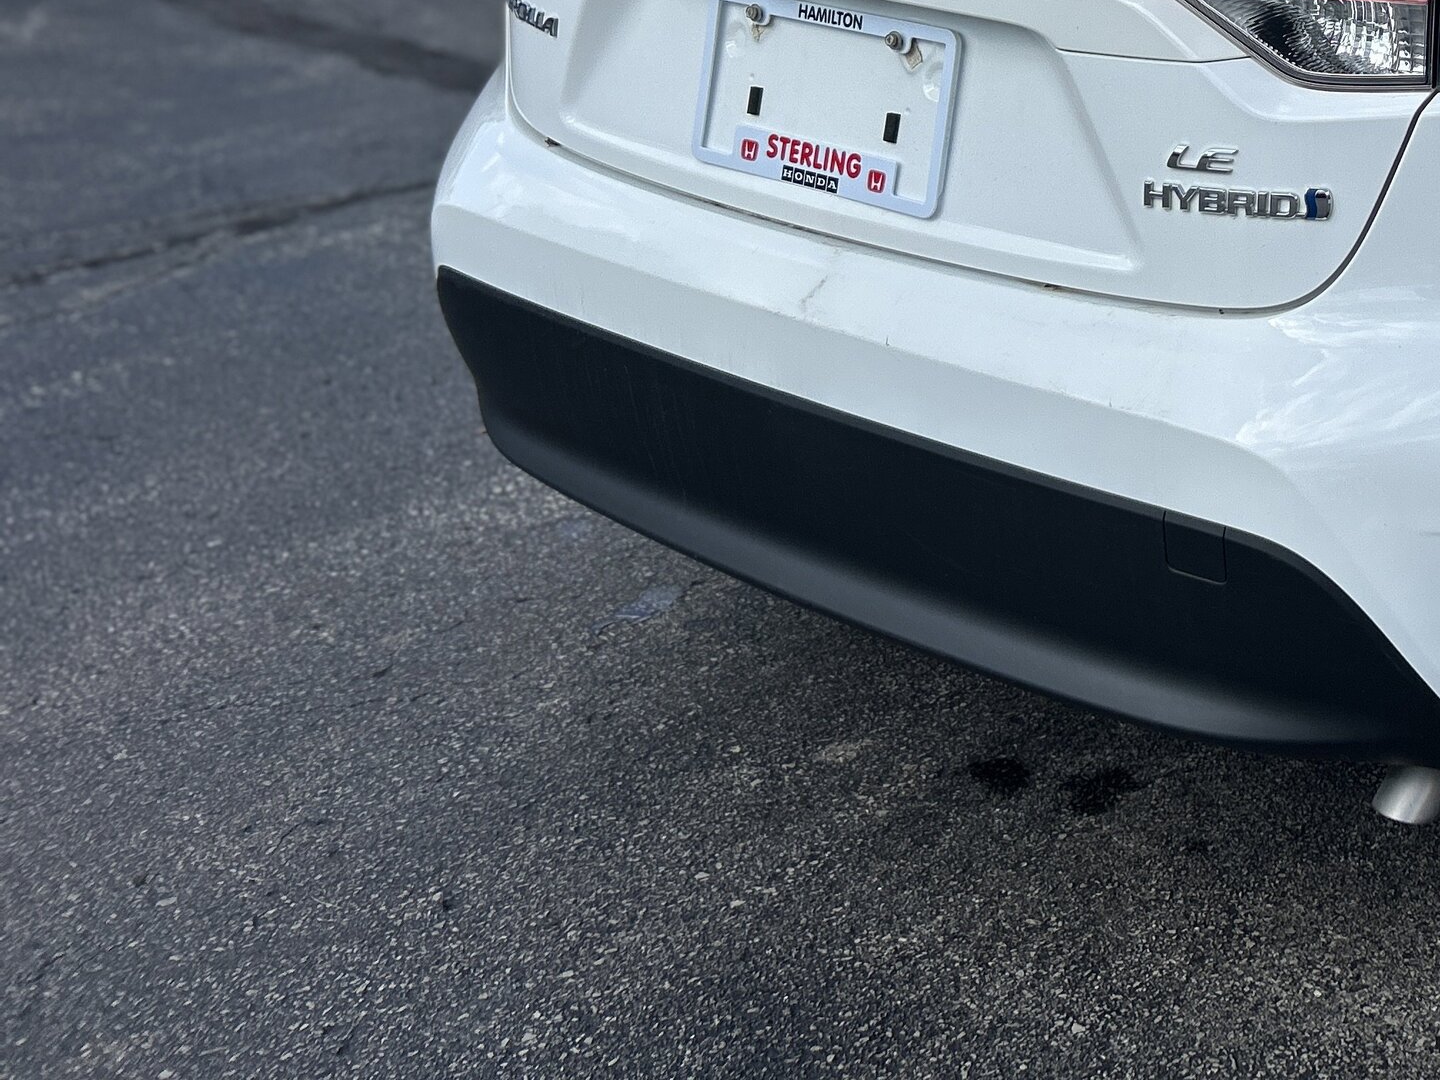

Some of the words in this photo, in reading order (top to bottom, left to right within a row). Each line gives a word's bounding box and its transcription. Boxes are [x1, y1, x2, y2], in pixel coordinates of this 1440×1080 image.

[798, 3, 863, 30] HAMILTON
[766, 133, 862, 179] STERLING
[1166, 143, 1240, 174] LE
[781, 165, 839, 193] HONDA
[1143, 180, 1300, 219] HYBRID
